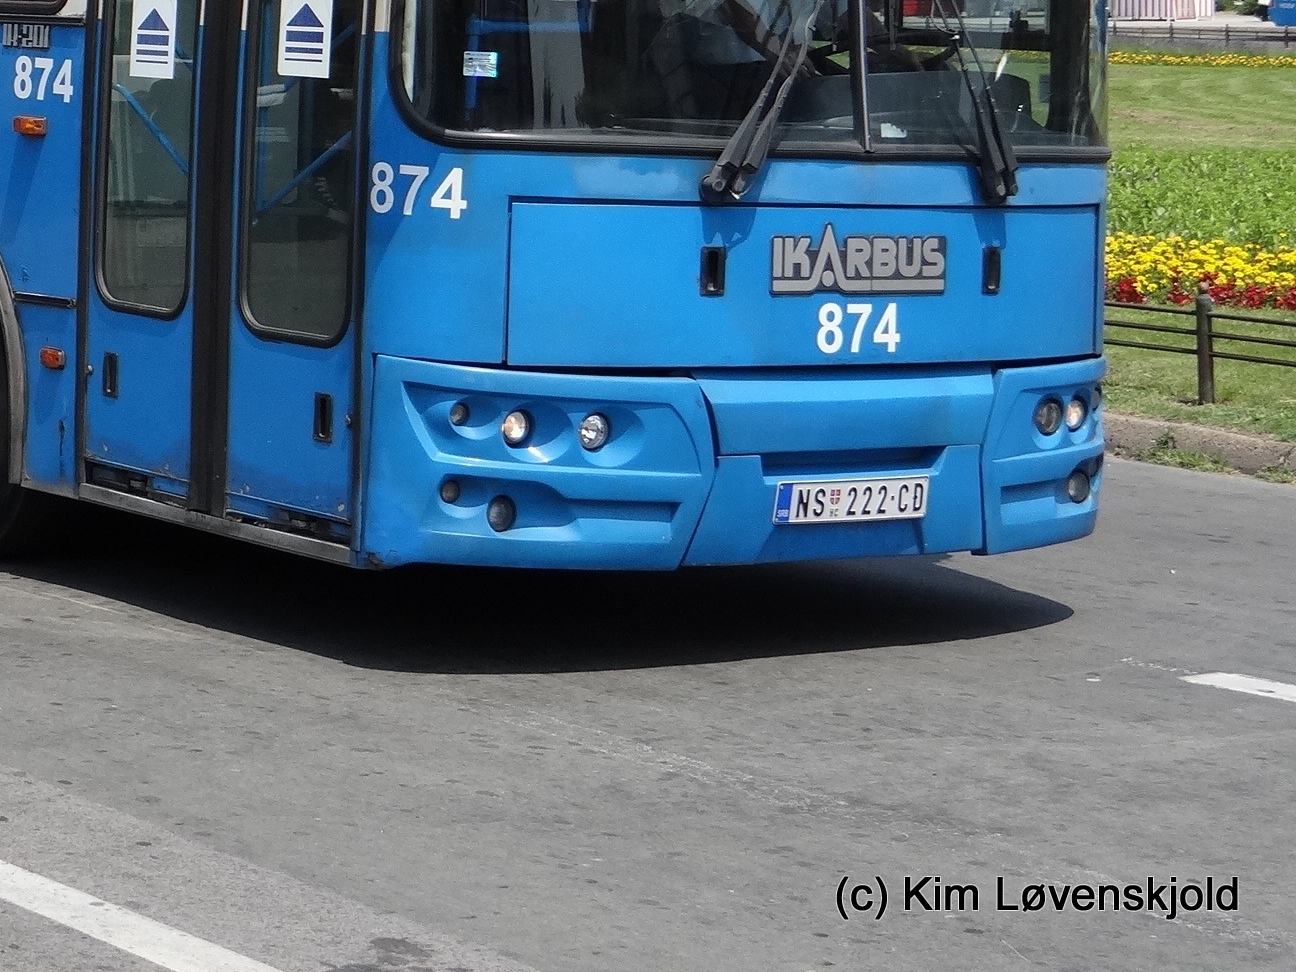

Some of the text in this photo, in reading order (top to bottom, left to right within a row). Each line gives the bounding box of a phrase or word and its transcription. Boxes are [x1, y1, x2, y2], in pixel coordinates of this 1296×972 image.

[13, 55, 74, 103] 874
[370, 161, 468, 220] 874
[771, 223, 945, 291] IKARBUS
[816, 302, 901, 354] 874
